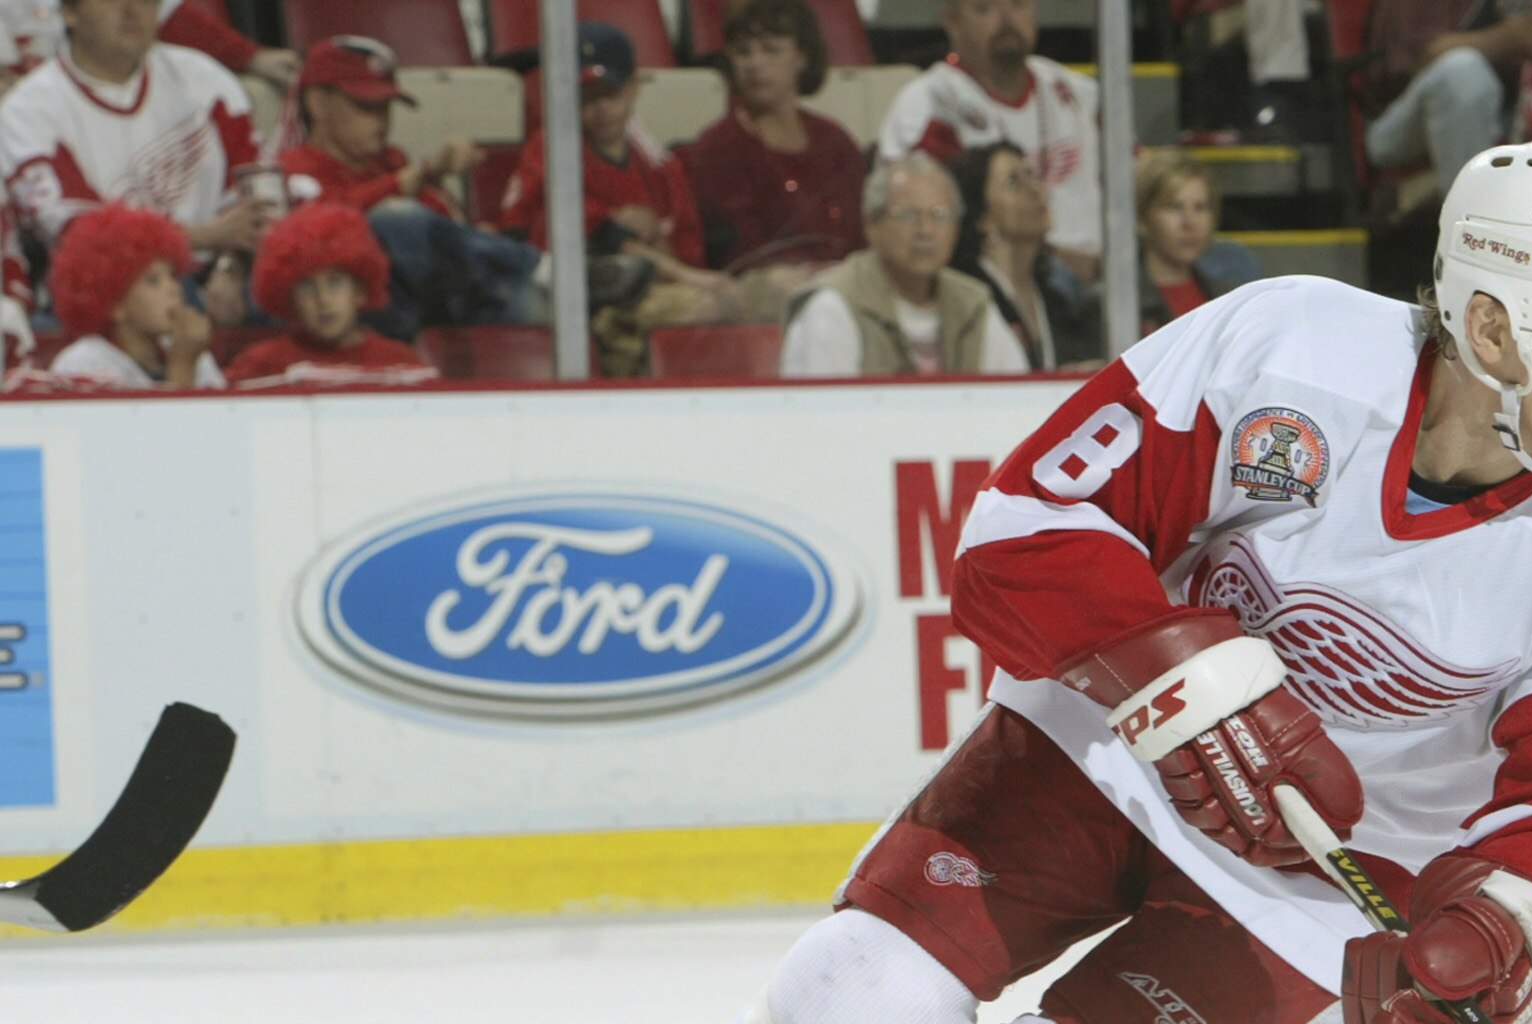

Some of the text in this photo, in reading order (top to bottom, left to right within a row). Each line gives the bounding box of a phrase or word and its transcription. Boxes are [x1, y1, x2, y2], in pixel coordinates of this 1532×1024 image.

[1462, 232, 1531, 266] Red Wings
[1032, 402, 1143, 499] 8
[1235, 465, 1312, 495] STANLEY CUP
[425, 521, 730, 659] Ford
[1196, 730, 1269, 827] LOUISVILLE
